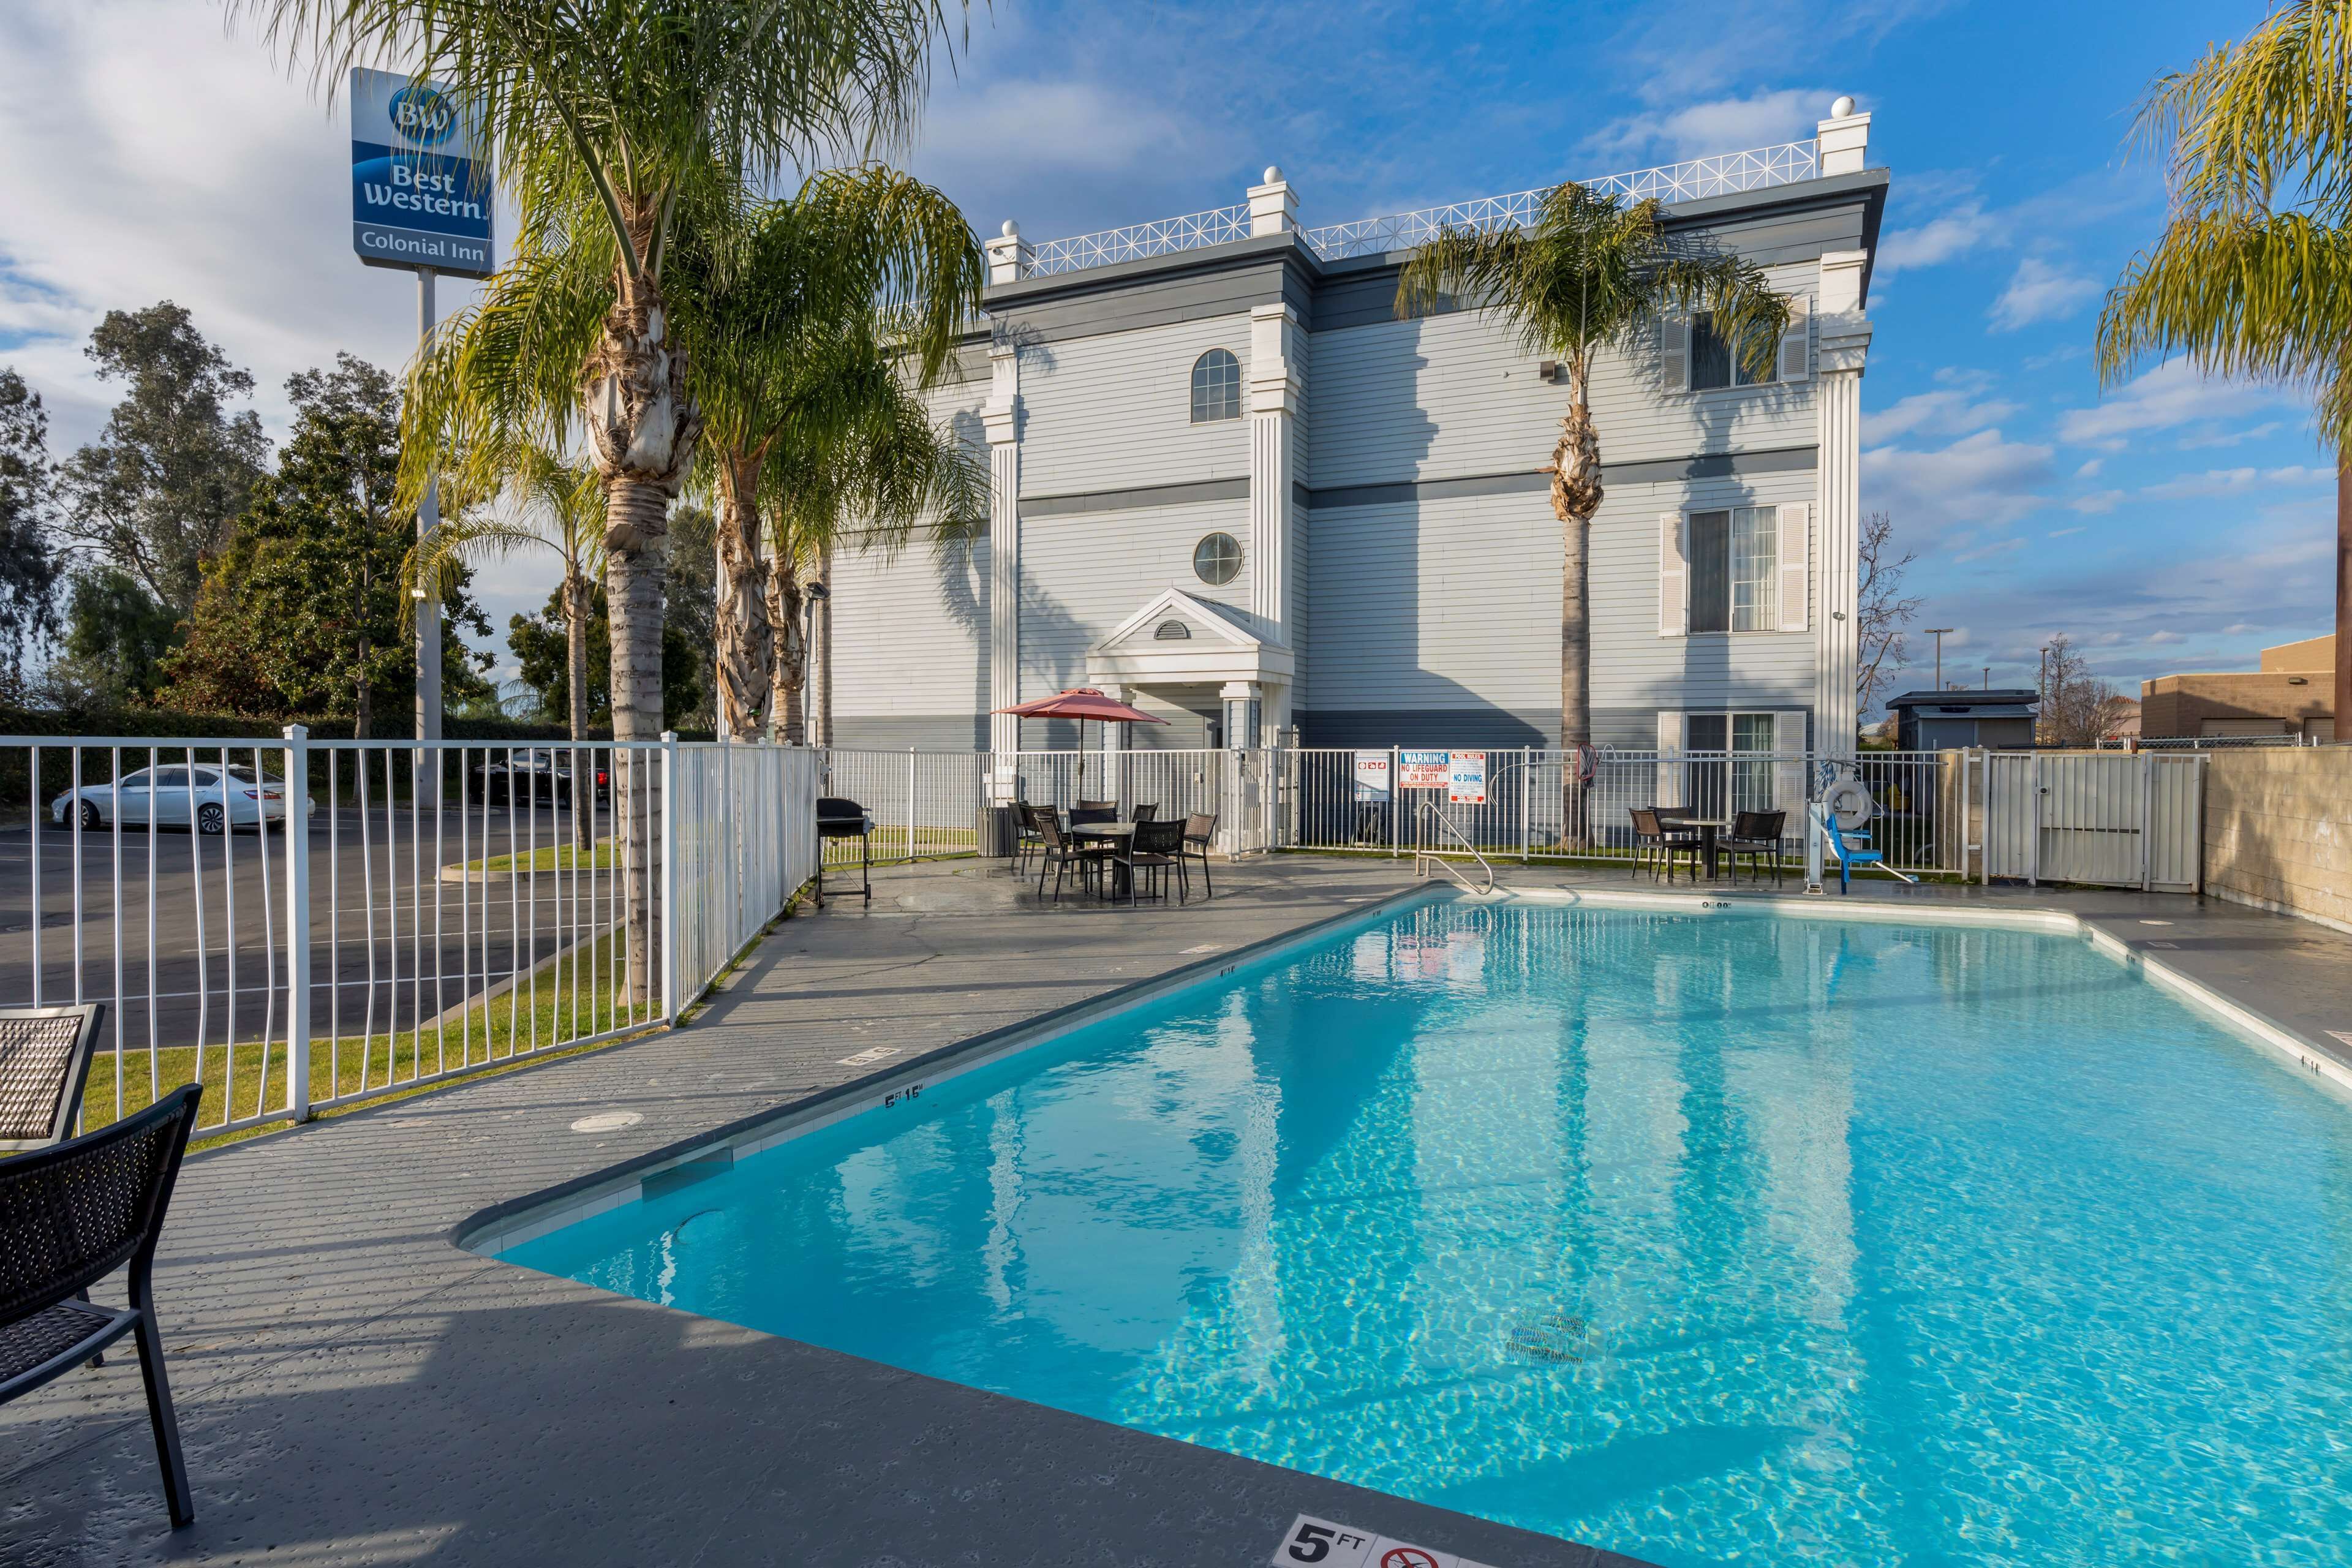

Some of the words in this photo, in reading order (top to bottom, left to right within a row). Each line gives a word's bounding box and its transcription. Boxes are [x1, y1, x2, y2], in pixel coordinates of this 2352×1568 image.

[398, 102, 448, 130] BW
[393, 164, 456, 194] Best
[364, 182, 482, 219] Western
[362, 231, 445, 257] Colonial
[452, 243, 484, 262] Inn
[1404, 753, 1446, 764] WARNING
[1412, 764, 1447, 772] LIFEGUARD
[1421, 773, 1438, 782] DUTY
[1463, 774, 1482, 782] DIVING
[1288, 1523, 1336, 1563] 5
[1336, 1533, 1366, 1550] FT
